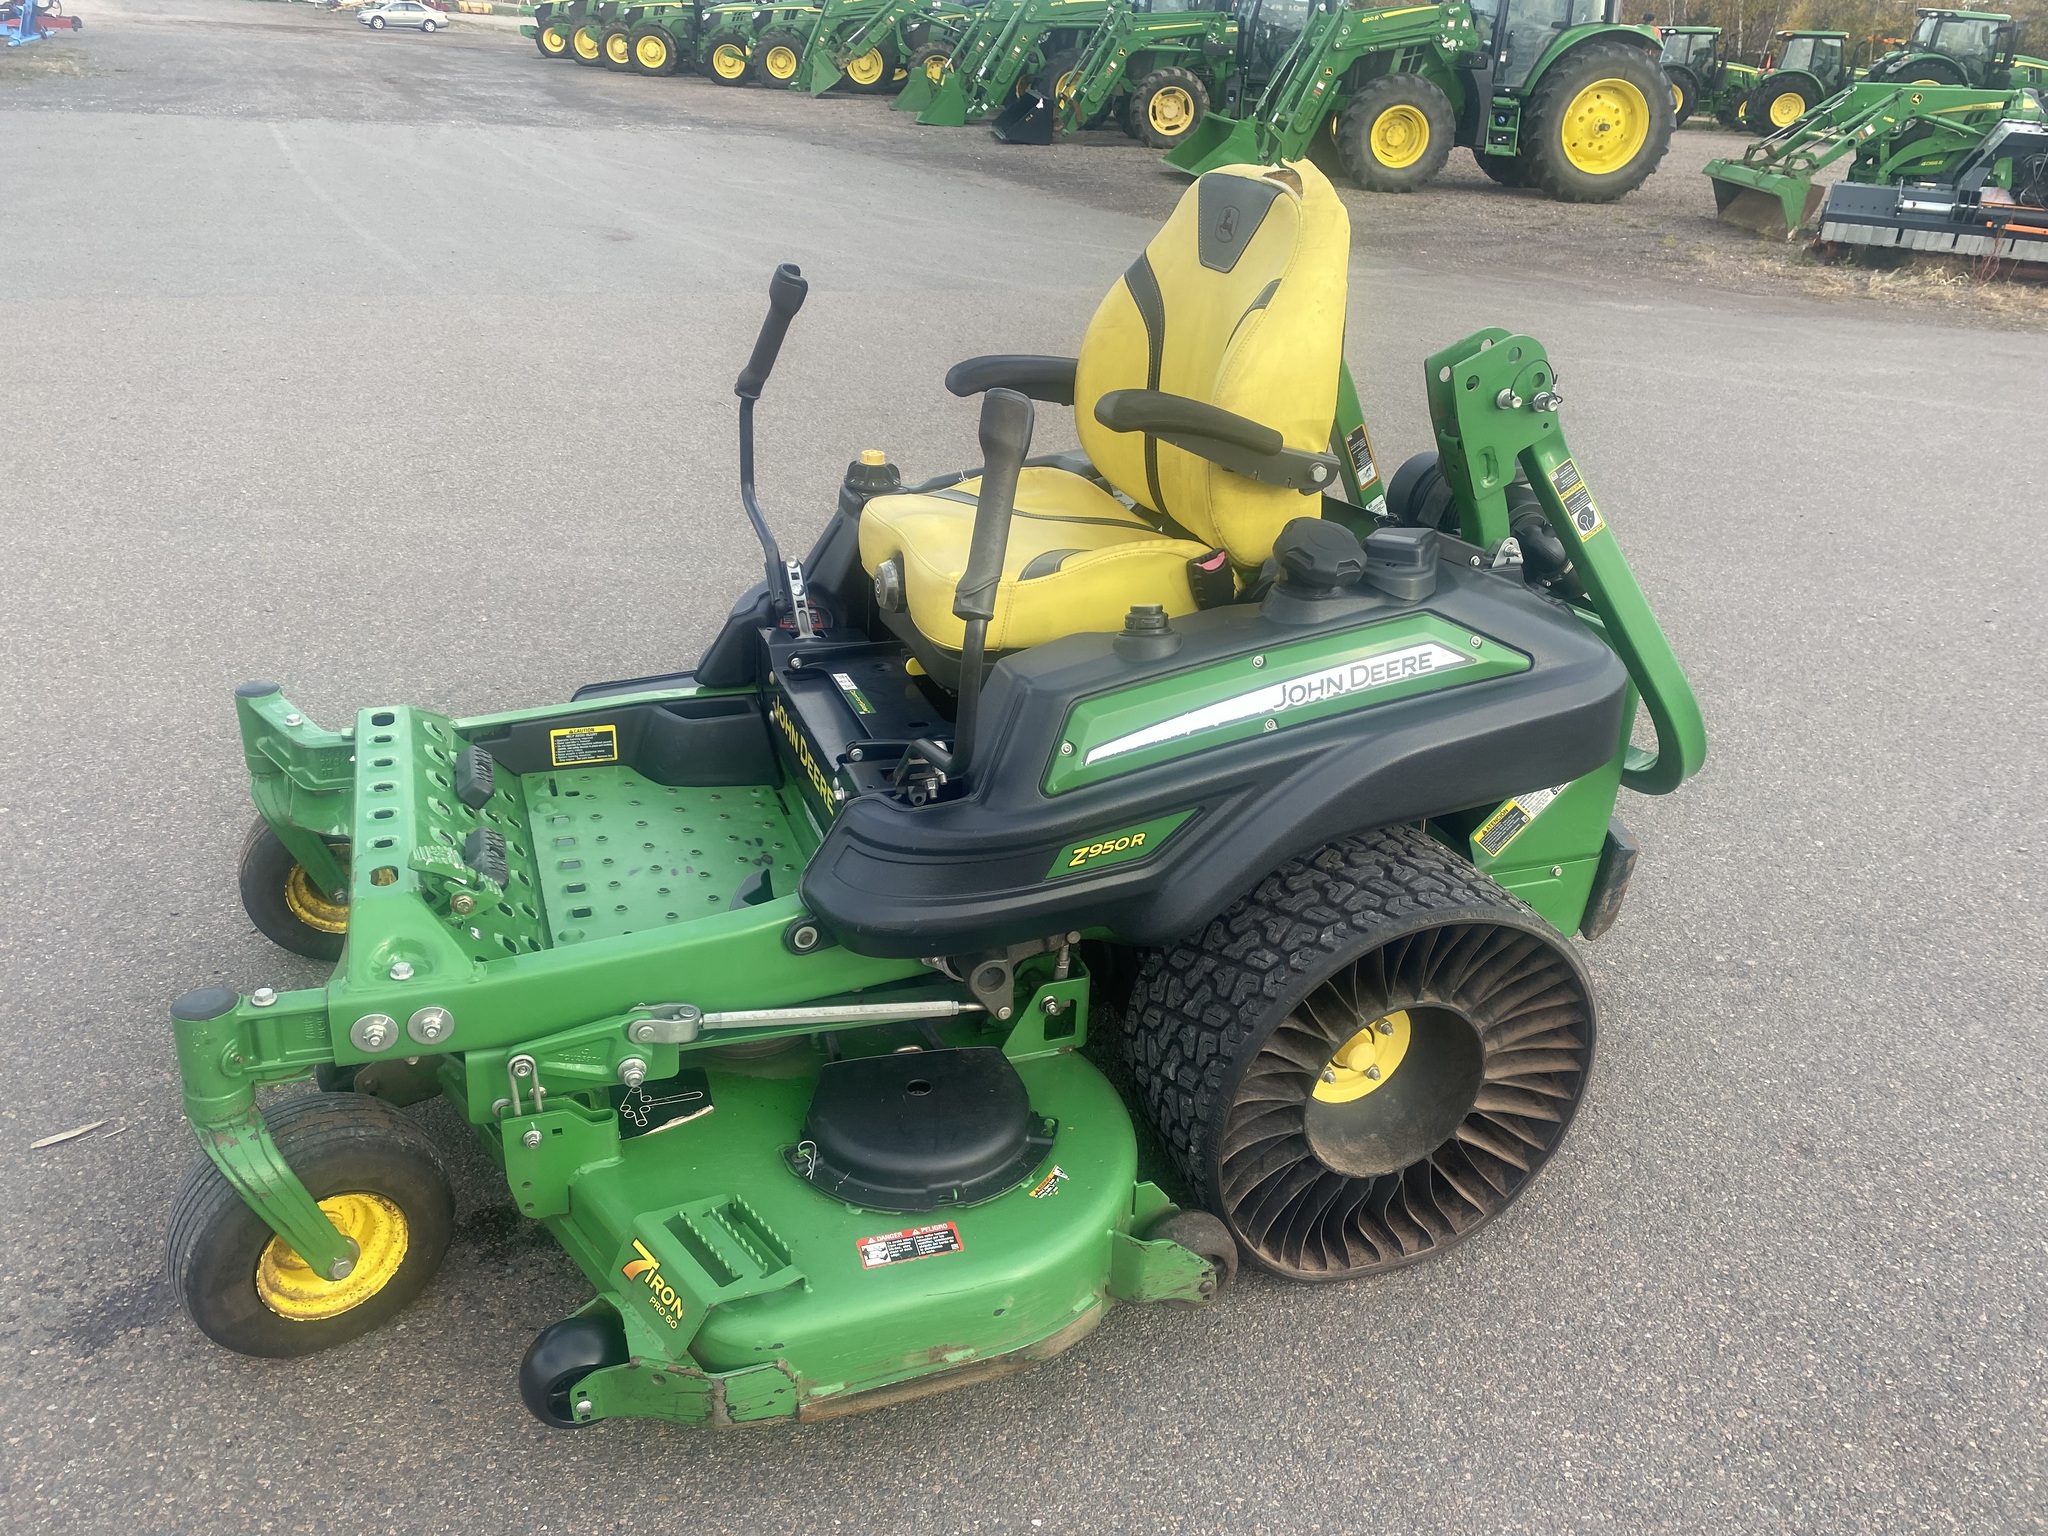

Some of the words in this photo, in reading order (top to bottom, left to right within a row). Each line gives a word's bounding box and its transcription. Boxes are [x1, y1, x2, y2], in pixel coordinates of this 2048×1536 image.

[1273, 674, 1343, 709] JOHN
[1350, 651, 1433, 688] DEERE
[774, 695, 799, 754] JOHN
[800, 734, 834, 817] DEERE
[1068, 832, 1147, 868] Z950R
[876, 1231, 903, 1241] DANGER
[920, 1222, 948, 1234] PELIGRO
[649, 1296, 666, 1316] PRO
[665, 1314, 678, 1329] 60
